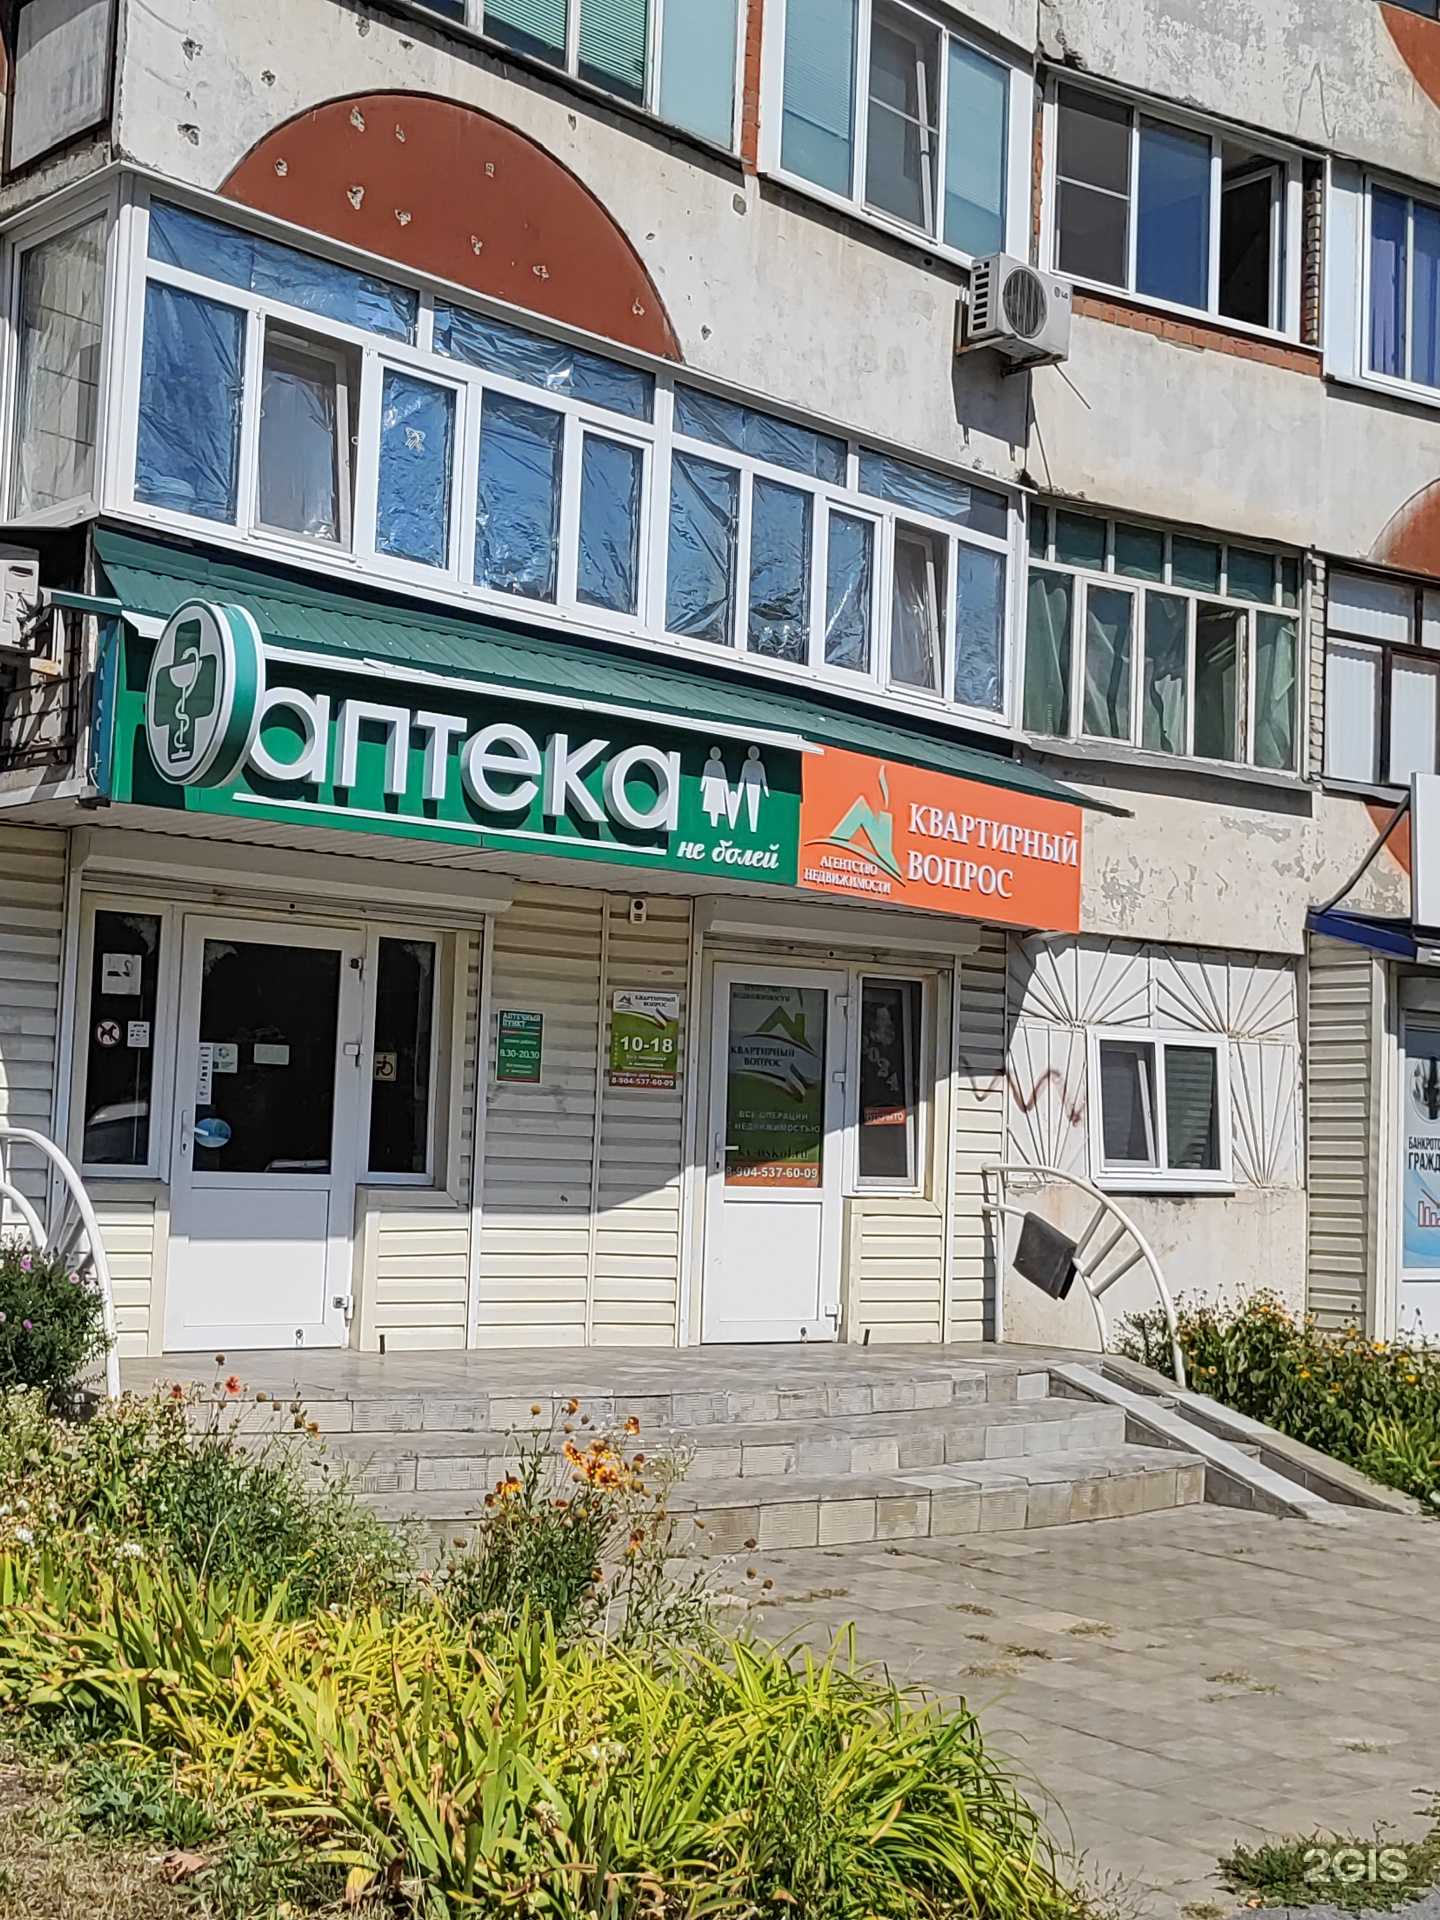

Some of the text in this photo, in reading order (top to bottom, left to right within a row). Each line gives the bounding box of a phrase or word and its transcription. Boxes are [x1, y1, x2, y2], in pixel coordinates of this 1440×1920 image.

[908, 803, 1080, 867] КВАРТИРНЫЙ
[677, 840, 780, 869] не болей
[820, 855, 878, 877] АГЕНТСТВО
[908, 850, 1013, 898] ВОПРОС
[804, 868, 891, 895] НЕДВИЖИМОСТИ
[620, 1036, 673, 1053] 10-18
[730, 1045, 795, 1058] КВАРТИРНЫЙ
[744, 1057, 782, 1068] ВОПРОС
[726, 1166, 818, 1179] 8-904-537-60-09
